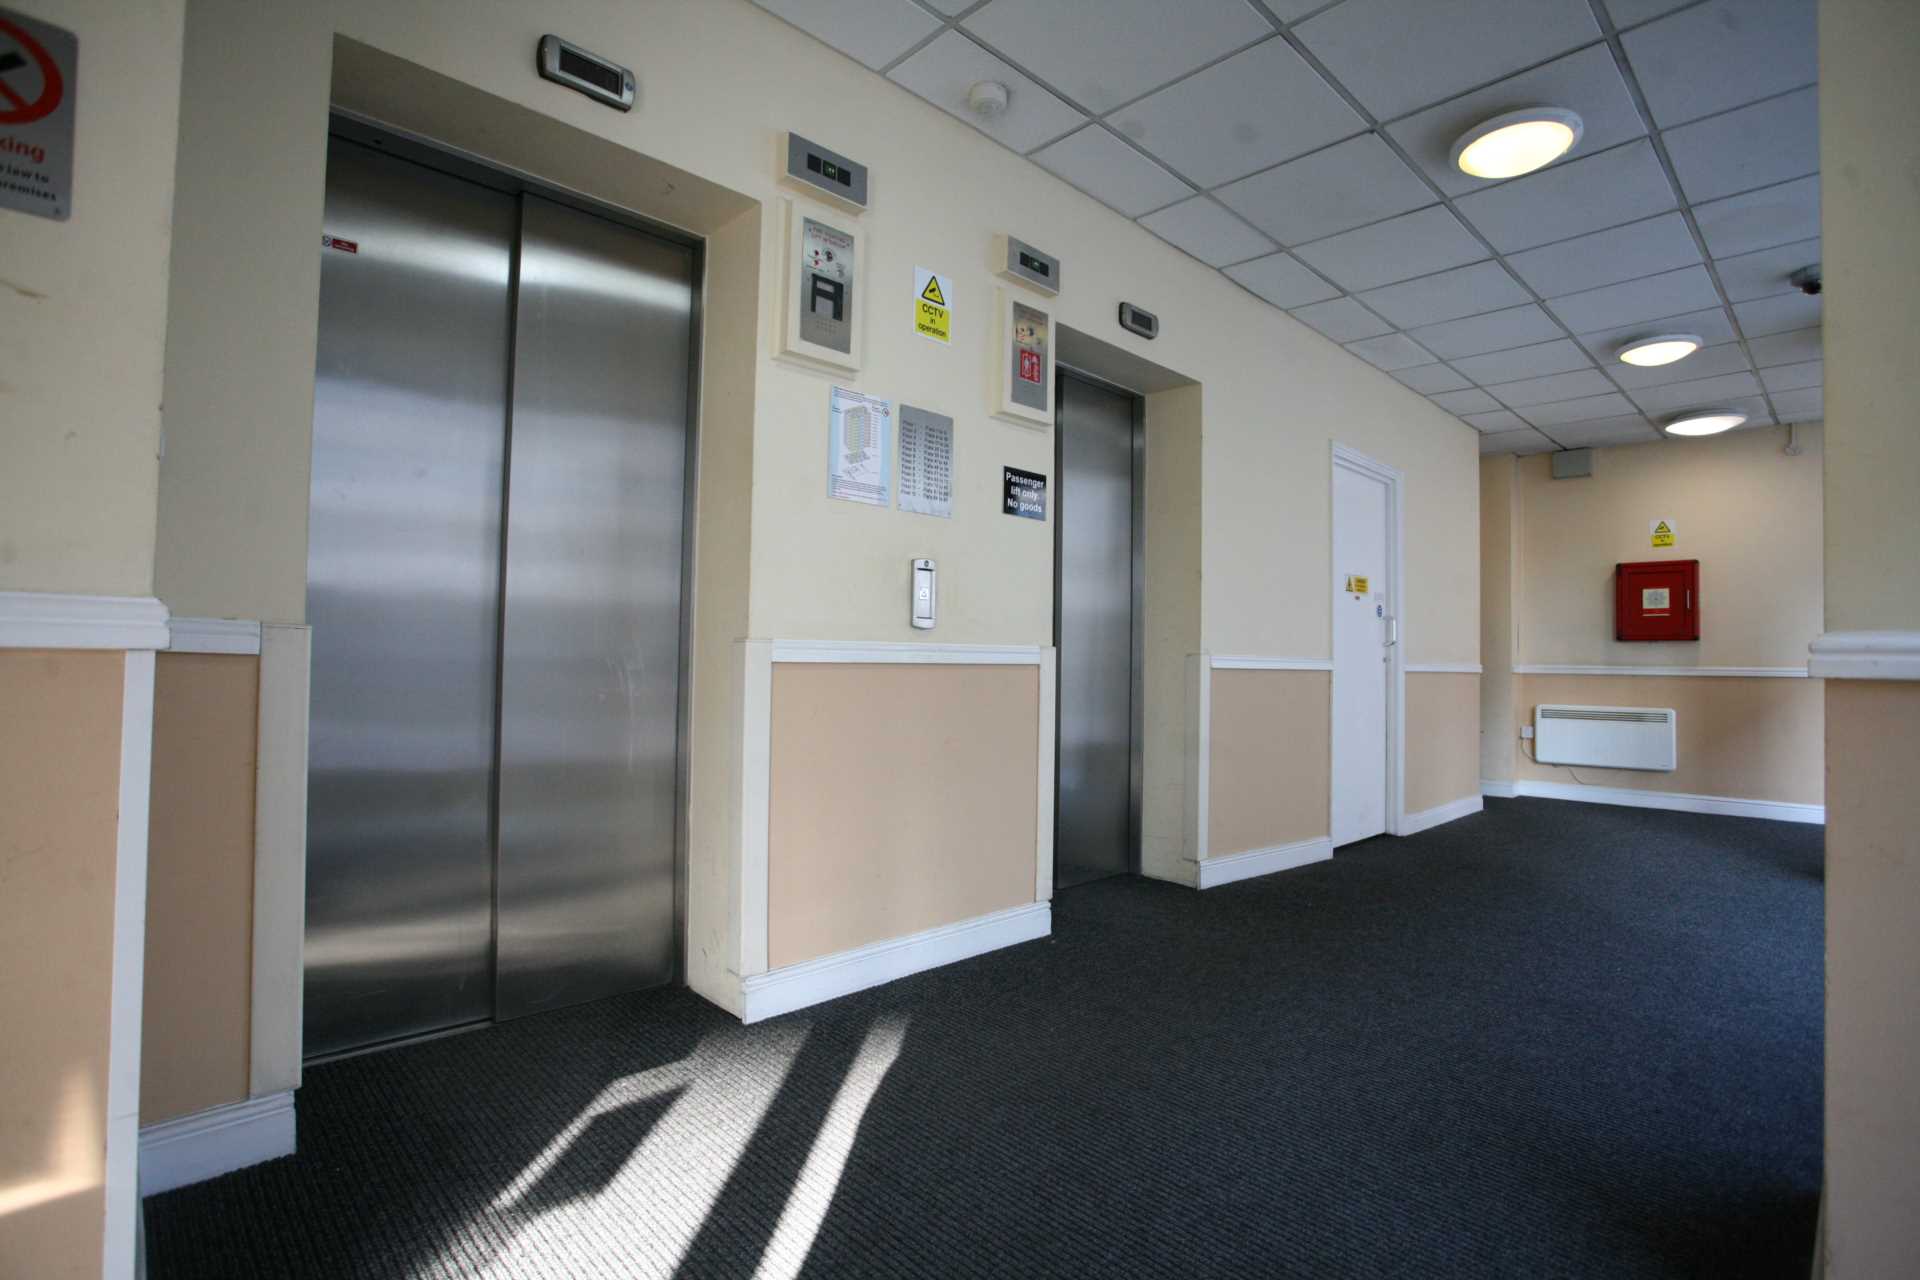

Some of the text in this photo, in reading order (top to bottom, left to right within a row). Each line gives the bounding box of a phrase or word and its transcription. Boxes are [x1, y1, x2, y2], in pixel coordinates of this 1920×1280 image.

[922, 303, 944, 319] CCTV
[929, 317, 936, 325] in
[918, 322, 945, 336] operation
[1005, 471, 1044, 489] Passenger
[1010, 484, 1021, 497] lift
[1007, 497, 1042, 513] No goods
